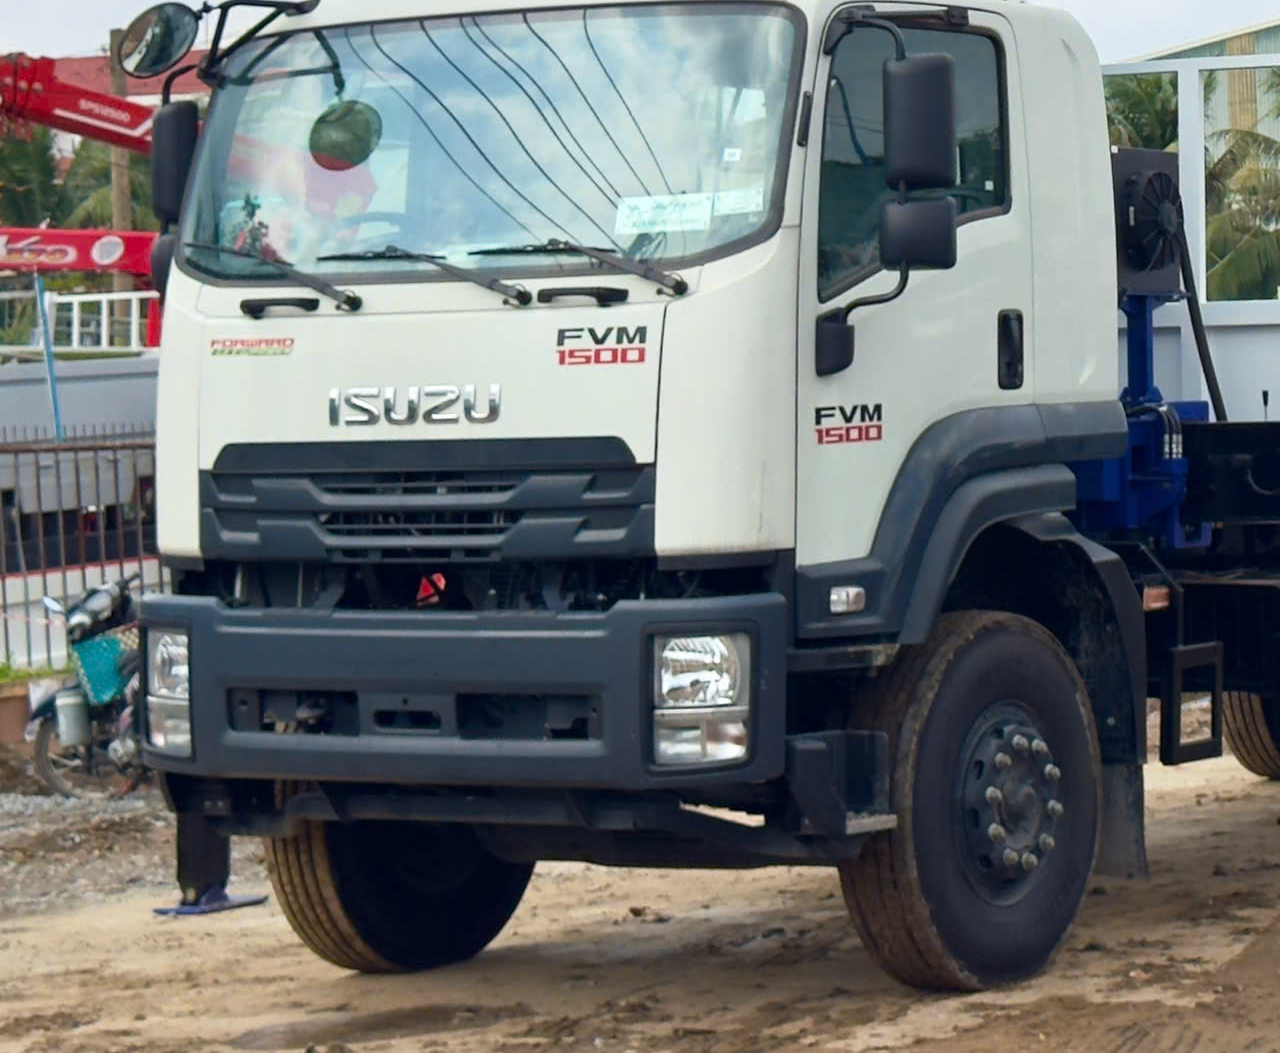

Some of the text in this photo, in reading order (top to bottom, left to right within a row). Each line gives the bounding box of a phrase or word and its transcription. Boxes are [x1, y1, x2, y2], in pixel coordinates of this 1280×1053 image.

[210, 337, 295, 349] FORWARD
[557, 325, 648, 346] FVM
[556, 346, 646, 366] 1500
[328, 382, 502, 427] ISUZU
[814, 402, 883, 427] FVM
[815, 423, 883, 446] 1500
